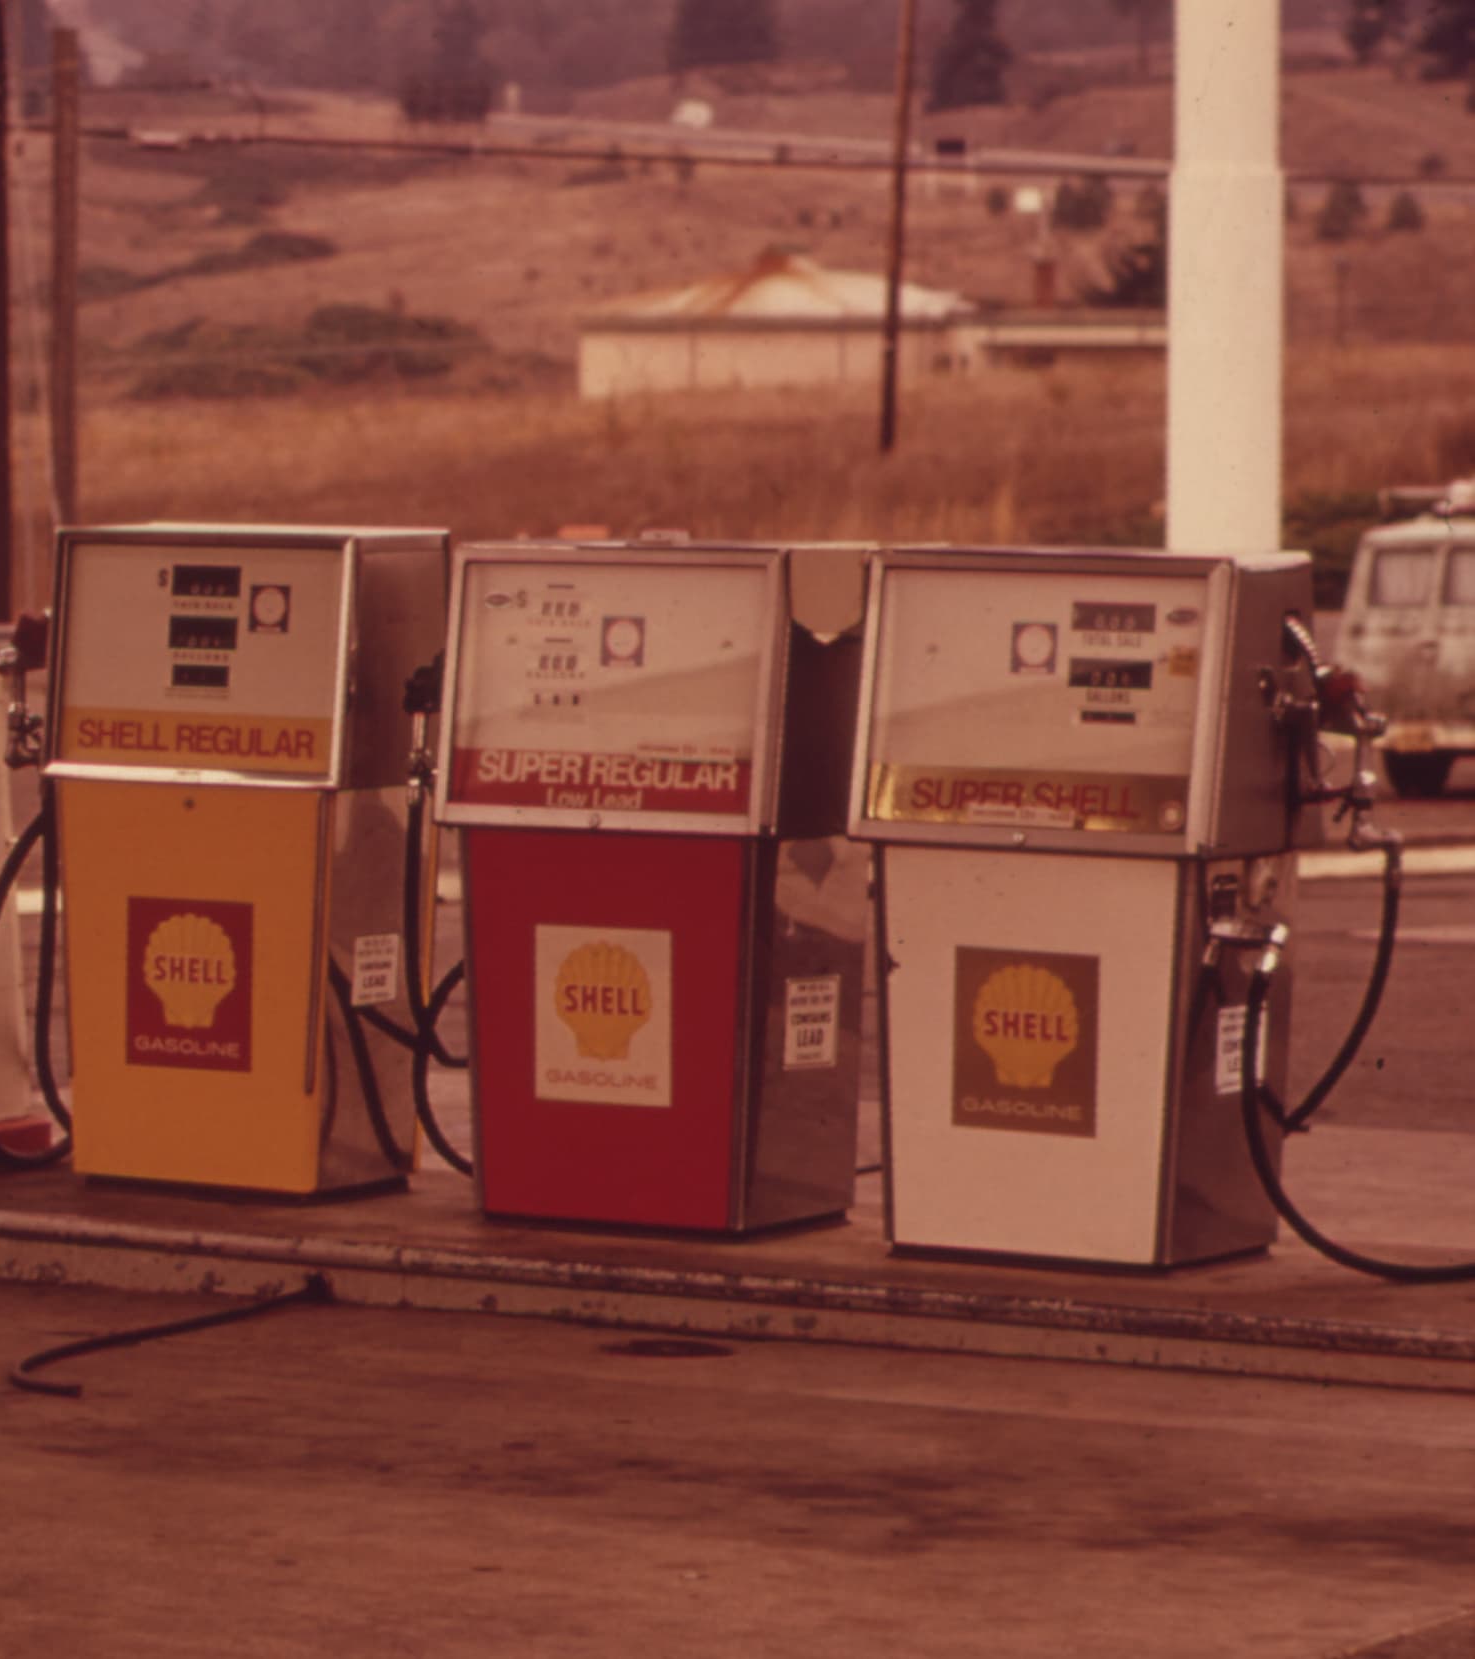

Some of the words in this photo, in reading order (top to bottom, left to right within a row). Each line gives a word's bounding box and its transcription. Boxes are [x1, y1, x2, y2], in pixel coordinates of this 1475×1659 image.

[78, 718, 169, 752] SHELL
[175, 722, 315, 759] REGULAR
[477, 750, 583, 785] SUPER
[587, 754, 739, 790] REGULAR
[546, 787, 588, 809] Low
[592, 788, 643, 810] Lead
[911, 778, 1025, 810] SUPER
[1034, 781, 1140, 819] SHELL
[154, 955, 228, 984] SHELL
[564, 984, 646, 1016] SHELL
[796, 1028, 823, 1048] LEAD
[983, 1009, 1070, 1042] SHELL
[134, 1034, 240, 1059] GASOLINE
[545, 1068, 658, 1090] GASOLINE
[962, 1096, 1083, 1121] GASOLINE
